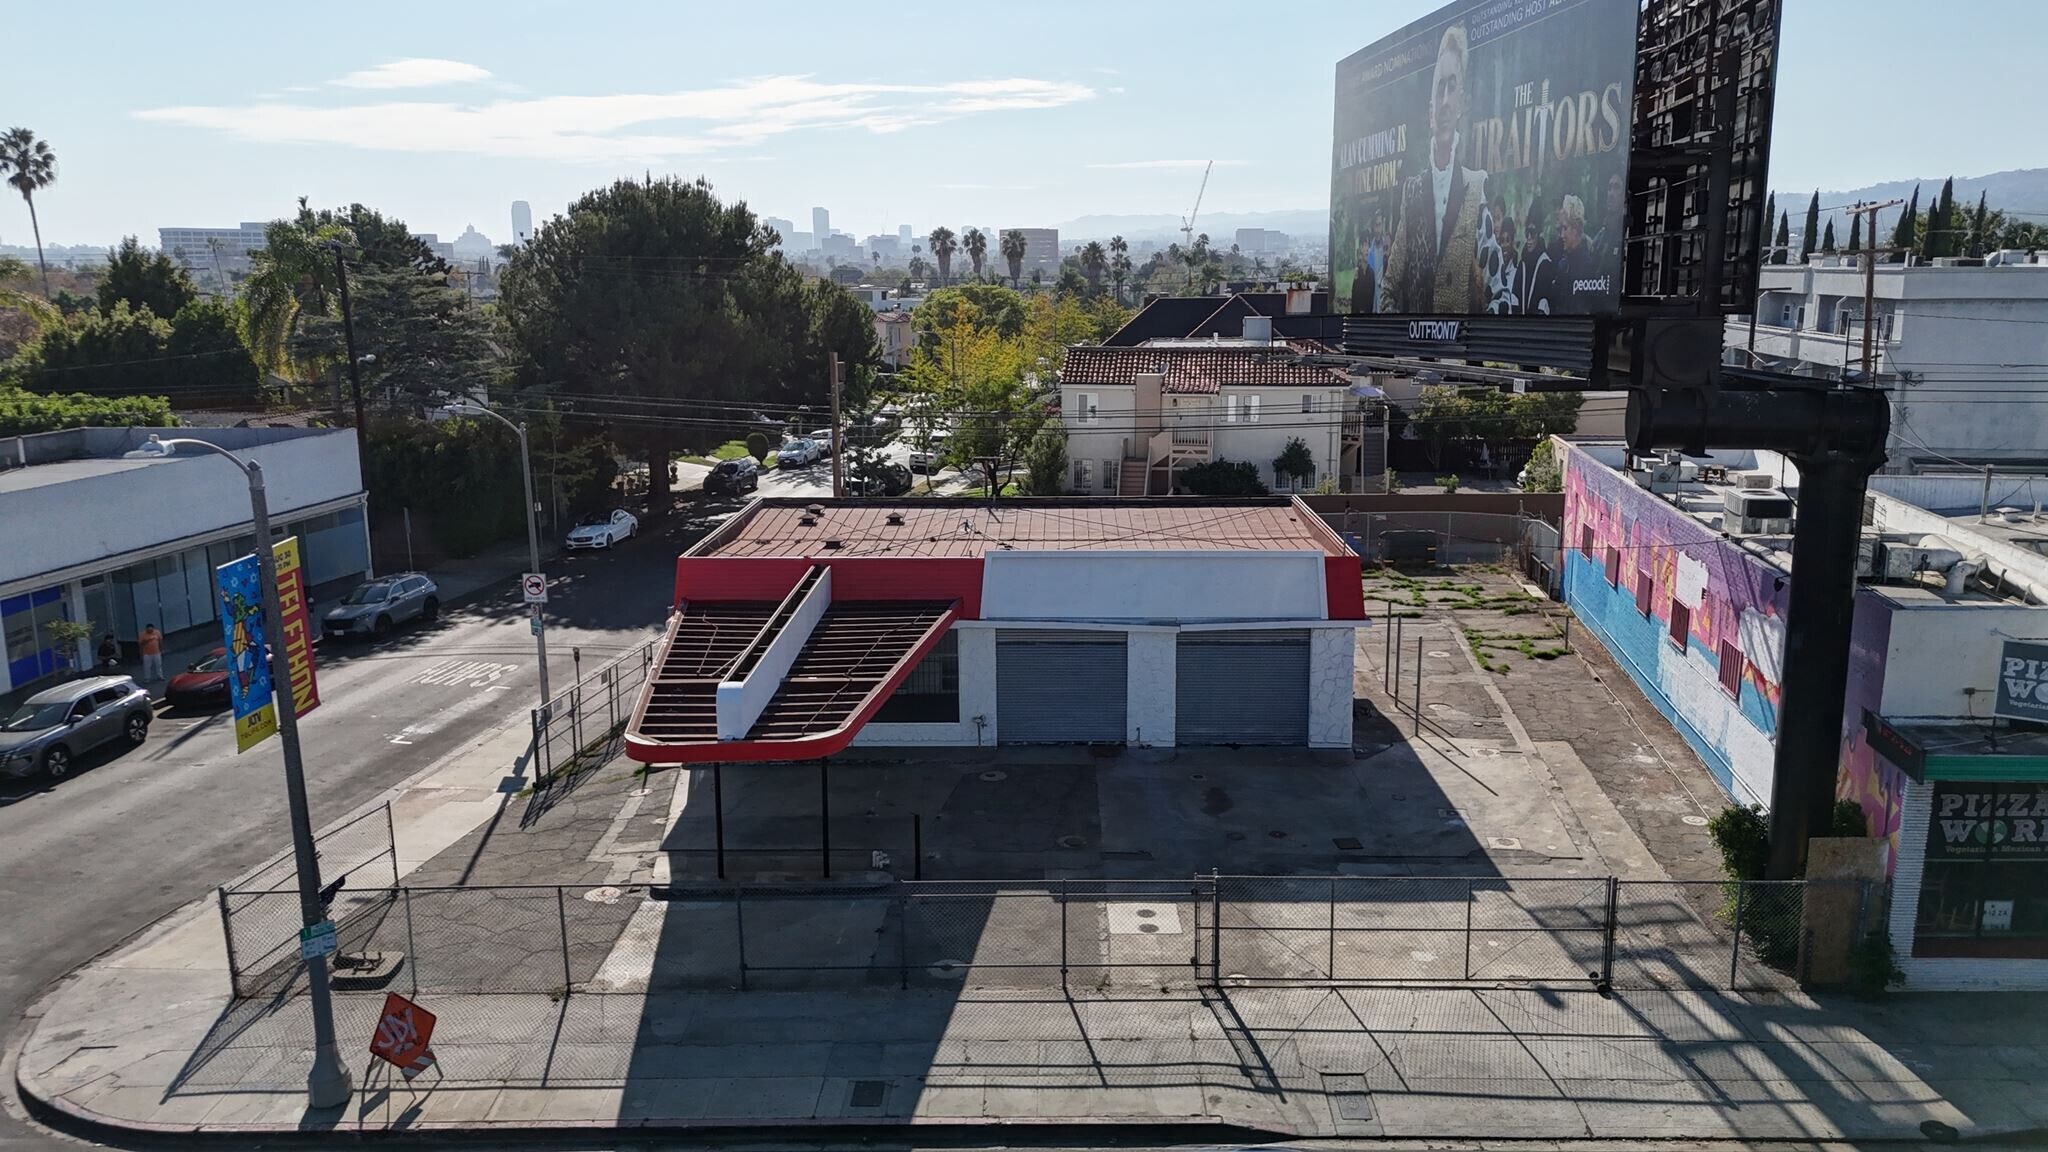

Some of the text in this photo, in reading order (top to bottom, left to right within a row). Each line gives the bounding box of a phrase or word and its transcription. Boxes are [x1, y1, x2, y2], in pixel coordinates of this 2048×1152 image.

[1471, 0, 1546, 41] OUTSTANDING HOST
[1514, 81, 1534, 108] THE
[1397, 123, 1407, 152] IS
[1472, 80, 1622, 175] TRAITORS
[1573, 274, 1607, 295] peacock
